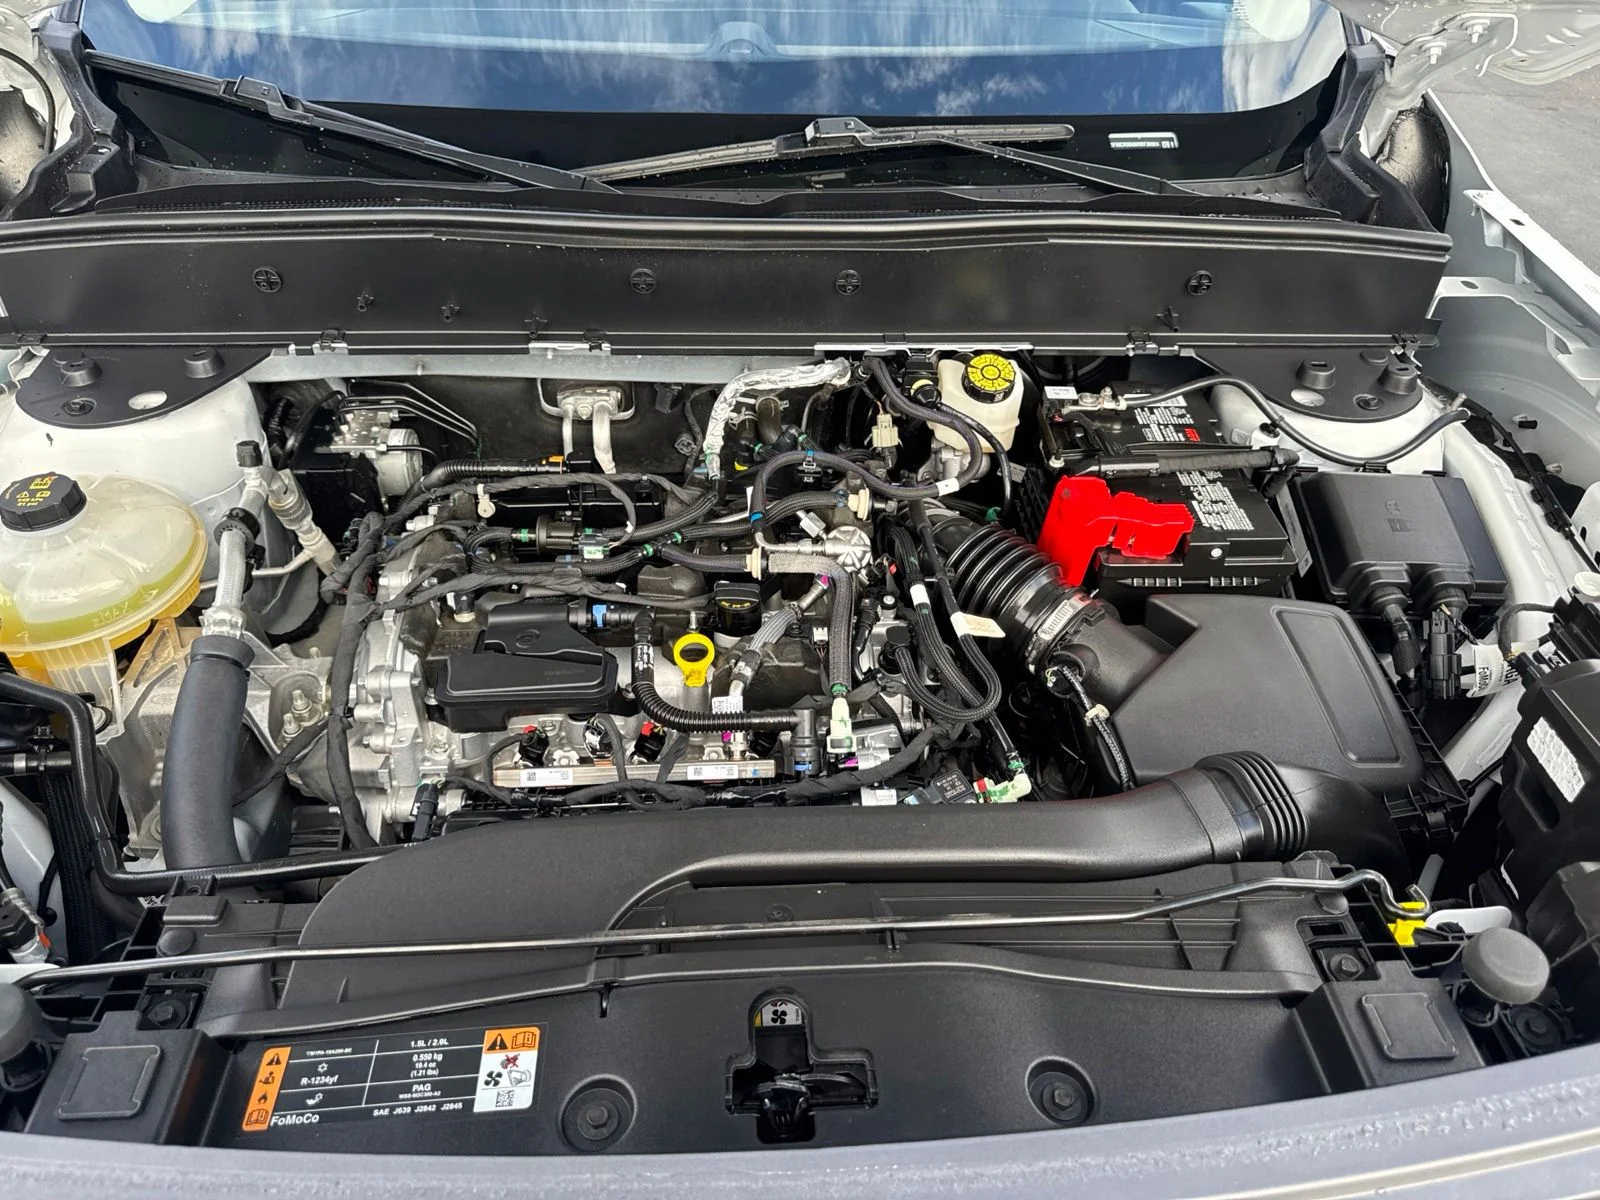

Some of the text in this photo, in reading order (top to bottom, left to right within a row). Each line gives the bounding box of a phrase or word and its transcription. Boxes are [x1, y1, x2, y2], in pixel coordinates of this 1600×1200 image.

[410, 1039, 427, 1048] 1.5L
[432, 1037, 449, 1046] 2.0L
[412, 1052, 444, 1062] 0.550 kg
[426, 1068, 440, 1077] lbs)
[300, 1074, 340, 1086] R-1234yf
[411, 1083, 433, 1092] PAG
[372, 1102, 463, 1117] SAE J639 J2842 J2845
[270, 1113, 320, 1127] FoMoCo
